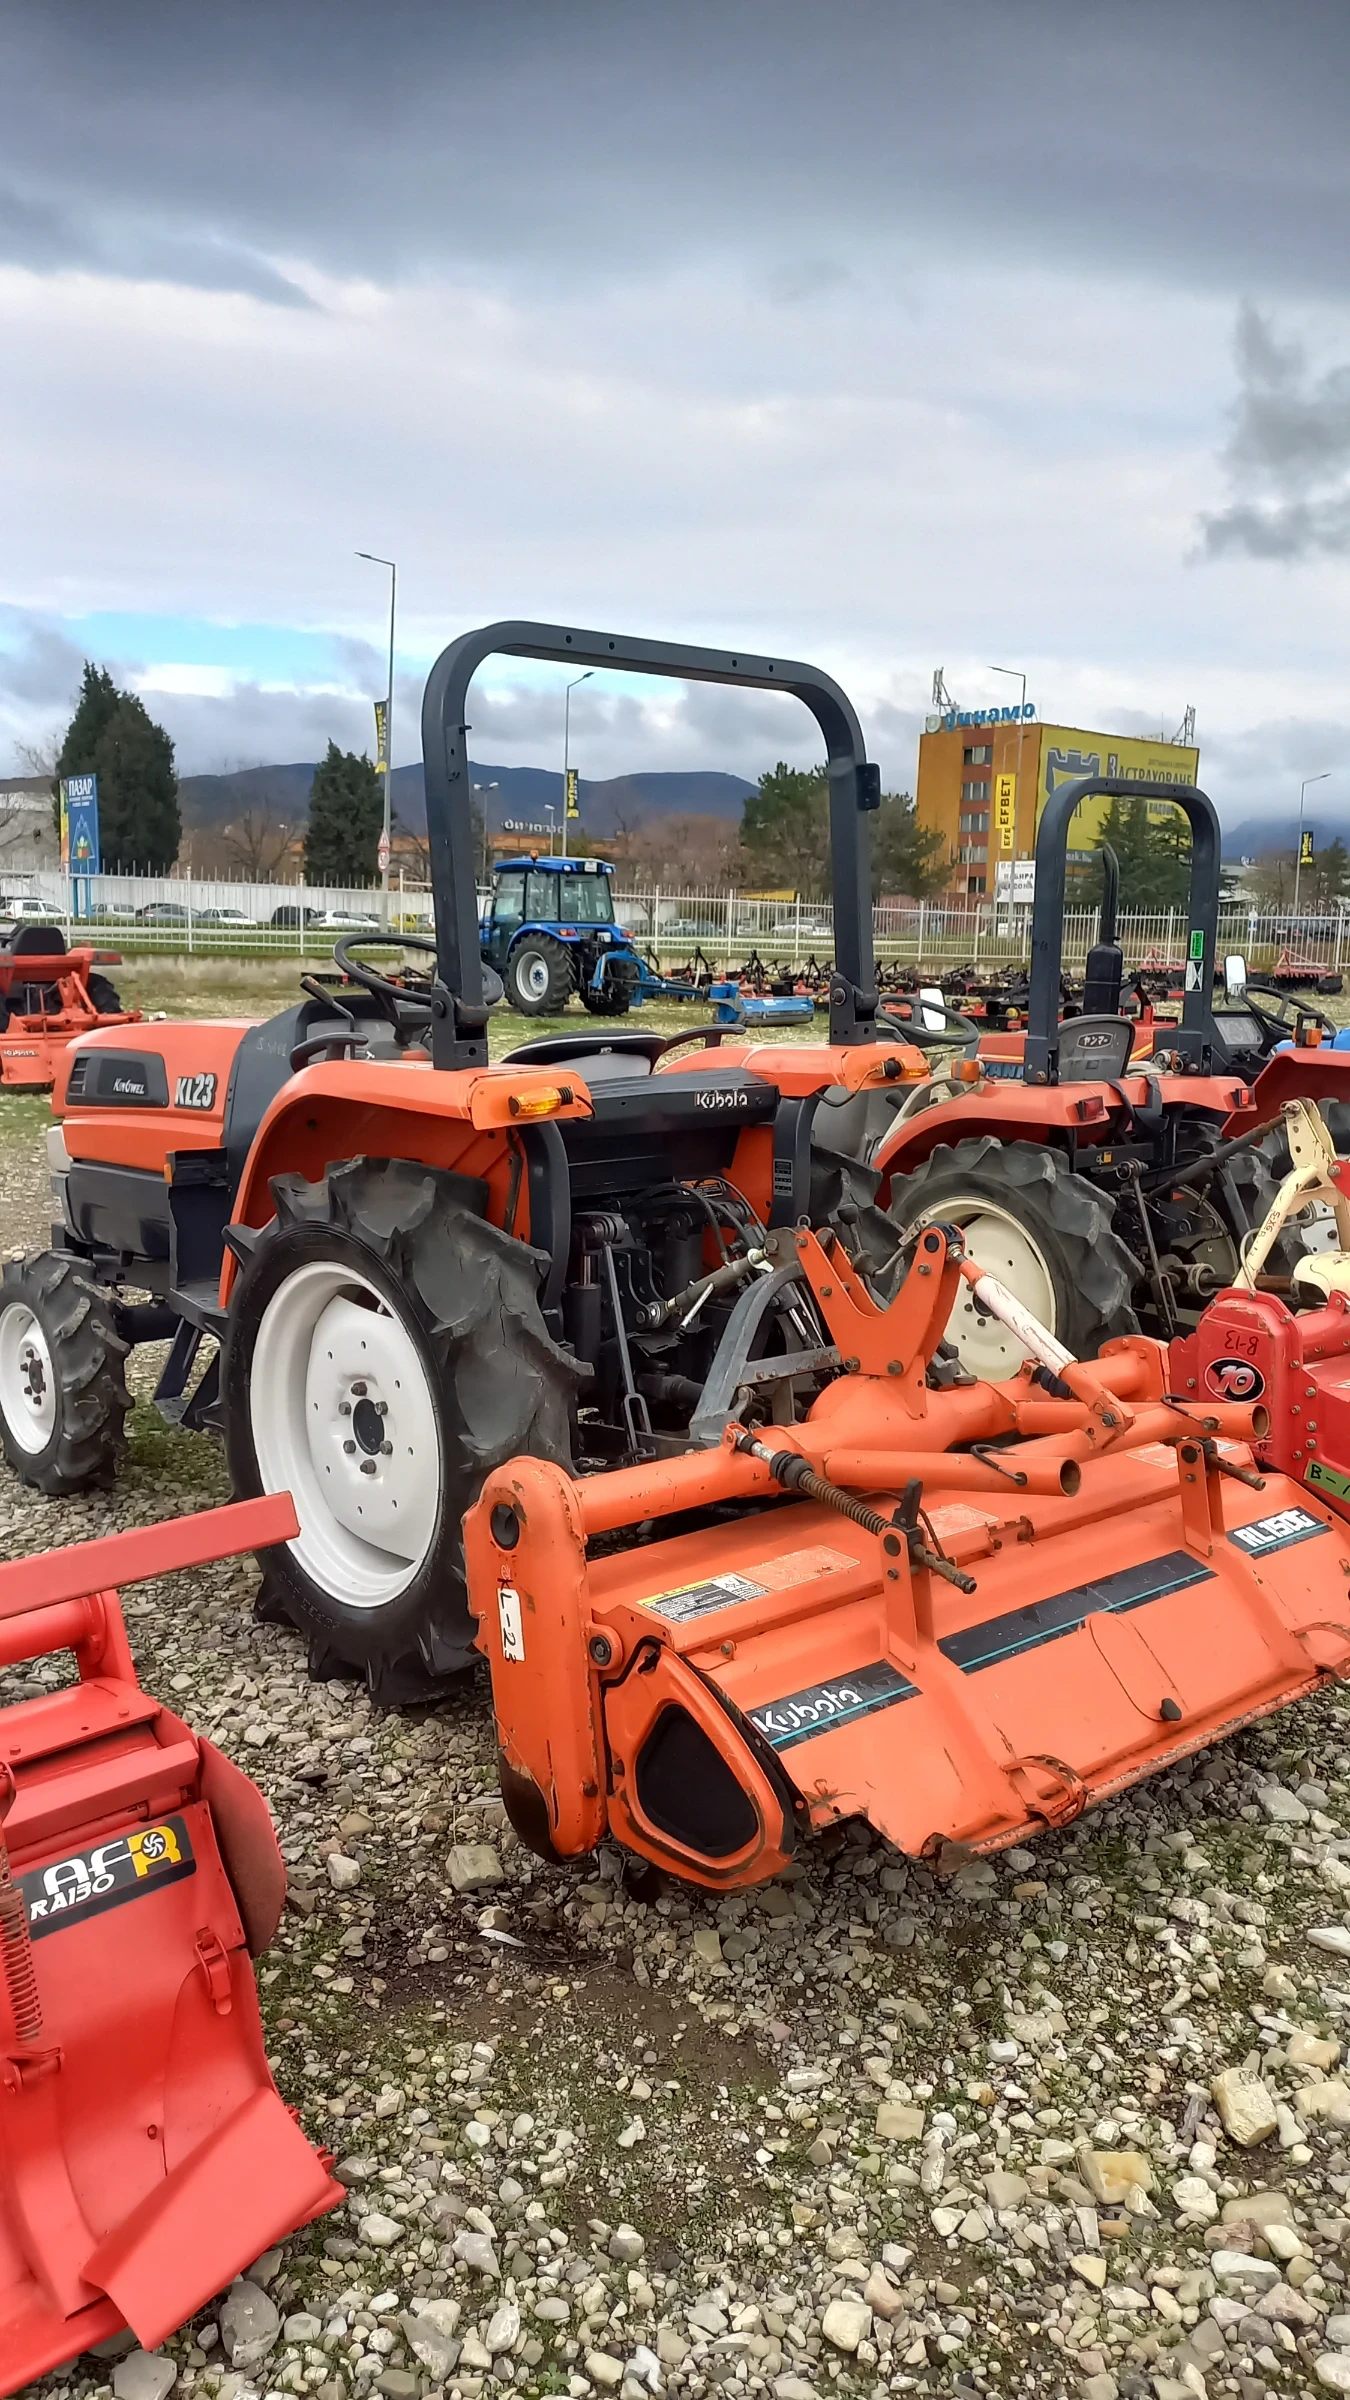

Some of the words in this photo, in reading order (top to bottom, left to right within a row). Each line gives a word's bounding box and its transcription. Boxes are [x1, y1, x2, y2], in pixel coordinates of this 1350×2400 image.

[68, 777, 93, 797] ПАЗАР
[1000, 778, 1011, 825] EFBET
[174, 1073, 214, 1108] KL23
[695, 1088, 748, 1109] Kubota
[751, 1689, 864, 1733] Kubota
[30, 1873, 115, 1921] RA130
